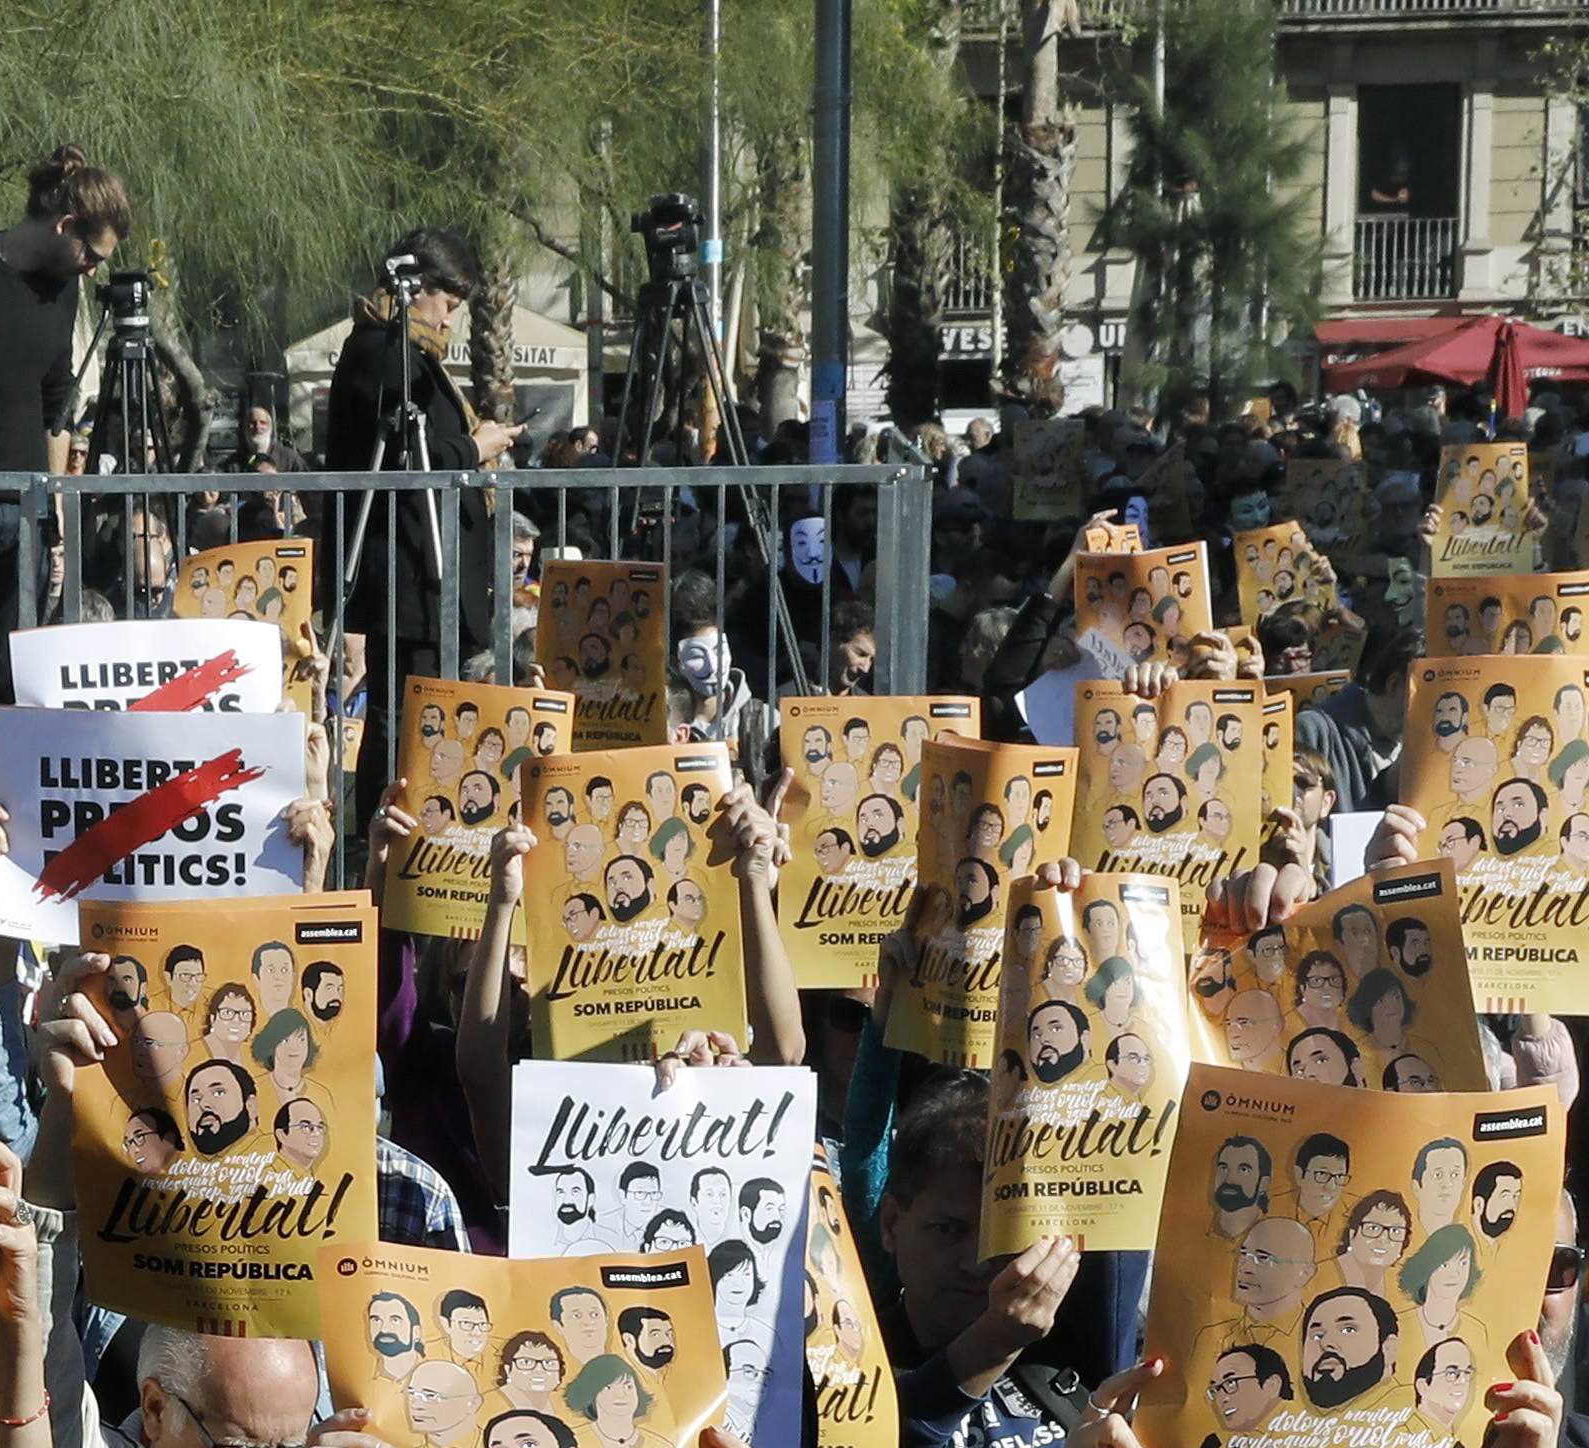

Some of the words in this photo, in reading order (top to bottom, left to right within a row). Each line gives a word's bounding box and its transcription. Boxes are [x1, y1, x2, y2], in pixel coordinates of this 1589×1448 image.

[548, 945, 718, 1000] Llibertat!
[528, 1091, 794, 1177] Llibertat!
[98, 1172, 353, 1245] Llibertat!
